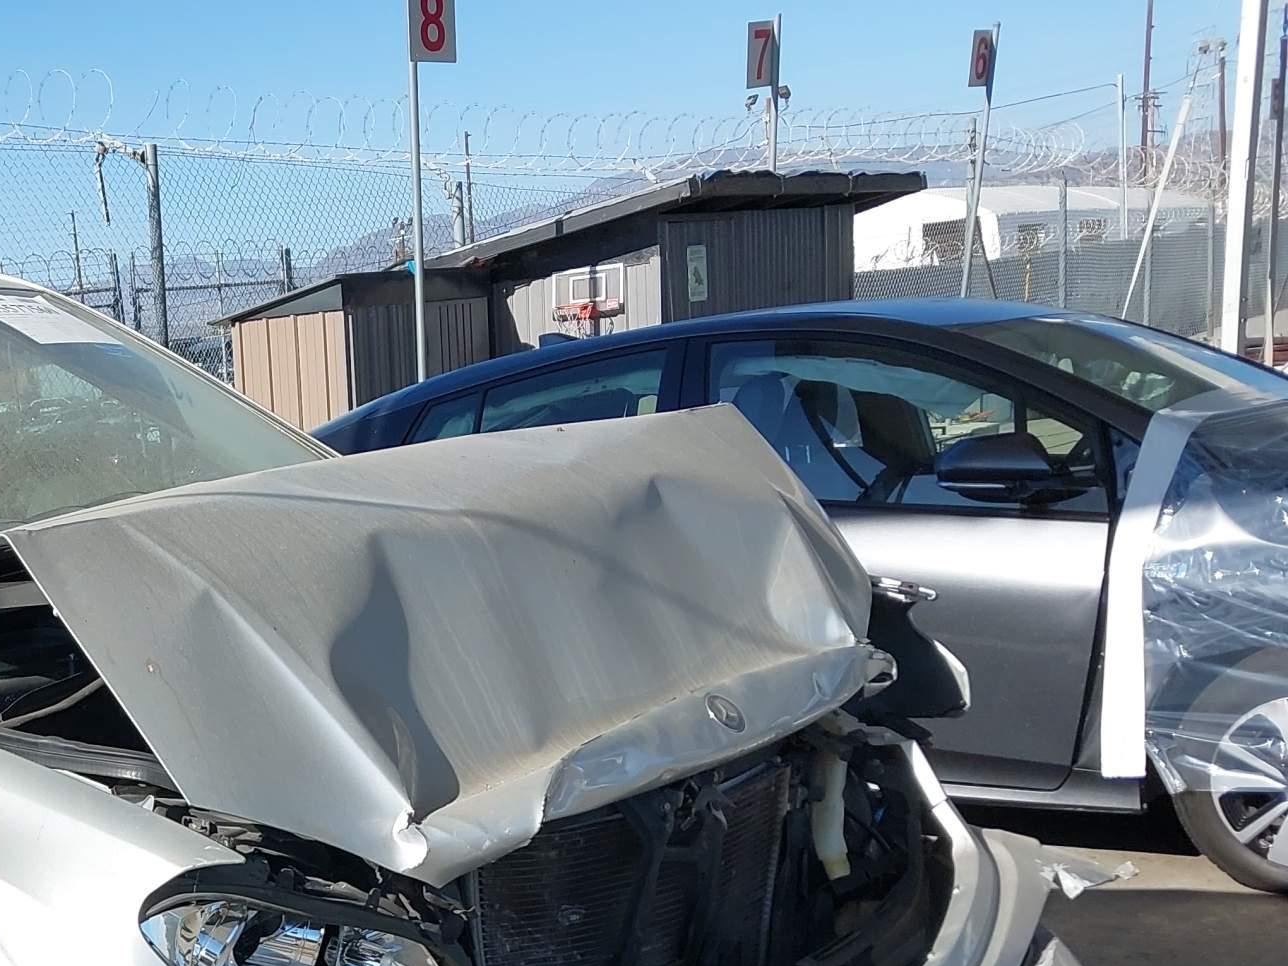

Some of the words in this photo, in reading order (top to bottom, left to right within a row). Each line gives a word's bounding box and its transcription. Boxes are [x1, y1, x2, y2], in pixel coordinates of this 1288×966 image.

[420, 0, 446, 52] 8
[754, 29, 771, 80] 7
[974, 36, 988, 80] 6
